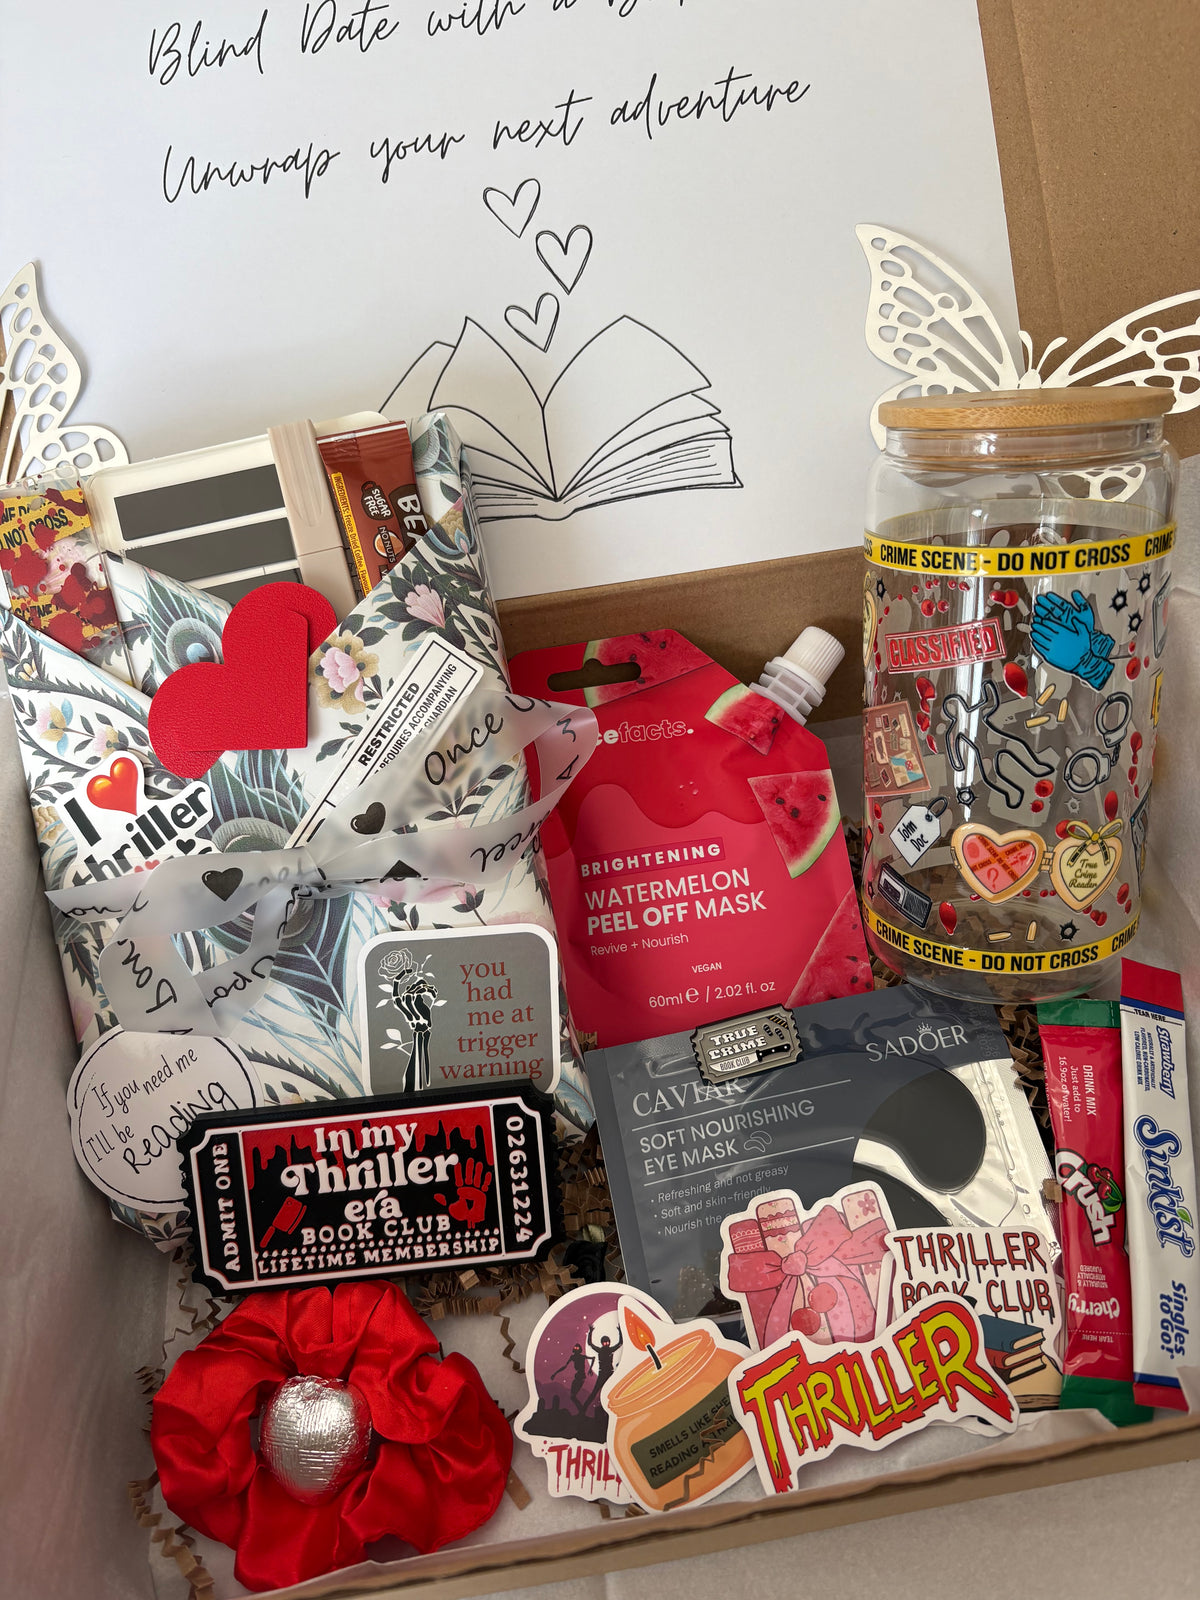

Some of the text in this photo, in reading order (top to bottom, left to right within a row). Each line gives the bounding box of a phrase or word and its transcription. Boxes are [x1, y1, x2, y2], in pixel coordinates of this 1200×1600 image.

[150, 9, 268, 85] Blind
[301, 0, 400, 53] Date
[163, 66, 811, 203] Unwrap your next adventure
[364, 495, 380, 517] FREE
[372, 488, 392, 518] SUGAR
[379, 526, 389, 539] NO
[384, 541, 396, 564] NUTS
[880, 543, 917, 567] CRIME
[921, 550, 977, 571] SCENE
[998, 552, 1023, 571] DO
[1030, 551, 1069, 571] NOT
[1075, 543, 1131, 568] CROSS
[1145, 530, 1173, 557] CRIME
[888, 625, 997, 667] CLASSIFIED
[408, 663, 457, 731] ACCOMPANYING
[357, 682, 420, 767] RESTRICTED
[424, 712, 504, 786] Once
[64, 797, 102, 847] I
[72, 786, 209, 888] thriller
[897, 820, 918, 842] John
[581, 843, 722, 878] BRIGHTENING
[1074, 868, 1098, 880] Crime
[1079, 858, 1098, 870] True
[584, 867, 751, 912] WATERMELON
[1068, 878, 1098, 889] Reader
[587, 890, 768, 937] PEEL OFF MASK
[590, 941, 628, 957] Revive
[642, 931, 690, 951] Nourish
[876, 918, 910, 951] CRIME
[913, 938, 964, 968] SCENE
[981, 954, 1005, 971] DO
[1010, 955, 1046, 972] NOT
[1049, 945, 1099, 970] CROSS
[1111, 923, 1137, 952] CRIME
[459, 959, 507, 985] you
[691, 961, 723, 975] VEGAN
[467, 979, 514, 1002] had
[648, 992, 684, 1009] 60ml
[714, 985, 743, 1001] 2.02
[745, 981, 759, 996] fl.
[760, 981, 777, 994] oz
[467, 1005, 535, 1026] me at
[457, 1031, 539, 1056] trigger
[708, 1036, 768, 1060] CRIME
[710, 1025, 759, 1046] TRUE
[438, 1053, 545, 1081] warning
[719, 1056, 751, 1072] BOOK CLUB
[1058, 1056, 1068, 1083] 16.9oz
[1156, 1025, 1176, 1100] Strawberry
[91, 1048, 198, 1118] If you need me
[1070, 1065, 1081, 1113] Just add to
[1082, 1064, 1097, 1117] DRINK MIX
[640, 1099, 816, 1154] SOFT NOURISHING
[1062, 1095, 1073, 1122] water!
[85, 1123, 135, 1163] I'll be
[313, 1122, 418, 1160] In my
[644, 1139, 740, 1177] EYE MASK
[280, 1152, 459, 1197] Thriller
[505, 1115, 534, 1244] 02631224
[658, 1164, 790, 1203] Refreshing and not greasy
[1134, 1114, 1195, 1258] Sunkist
[212, 1142, 241, 1273] ADMIT ONE
[343, 1188, 403, 1223] era
[661, 1206, 682, 1220] Soft
[684, 1201, 703, 1215] and
[1055, 1148, 1116, 1248] Crush
[301, 1213, 451, 1246] BOOK CLUB
[664, 1214, 723, 1238] Nourish the
[257, 1236, 500, 1275] LIFETIME MEMBERSHIP
[893, 1231, 1048, 1284] THRILLER
[985, 1278, 1056, 1325] CLUB
[1068, 1292, 1120, 1319] Cherry
[1159, 1292, 1173, 1315] to
[1171, 1279, 1190, 1356] Singles
[736, 1302, 1014, 1494] THRILLER
[649, 1430, 689, 1459] SMELLS
[688, 1414, 713, 1435] LIKE
[547, 1443, 623, 1496] THRIL
[649, 1443, 699, 1478] READING
